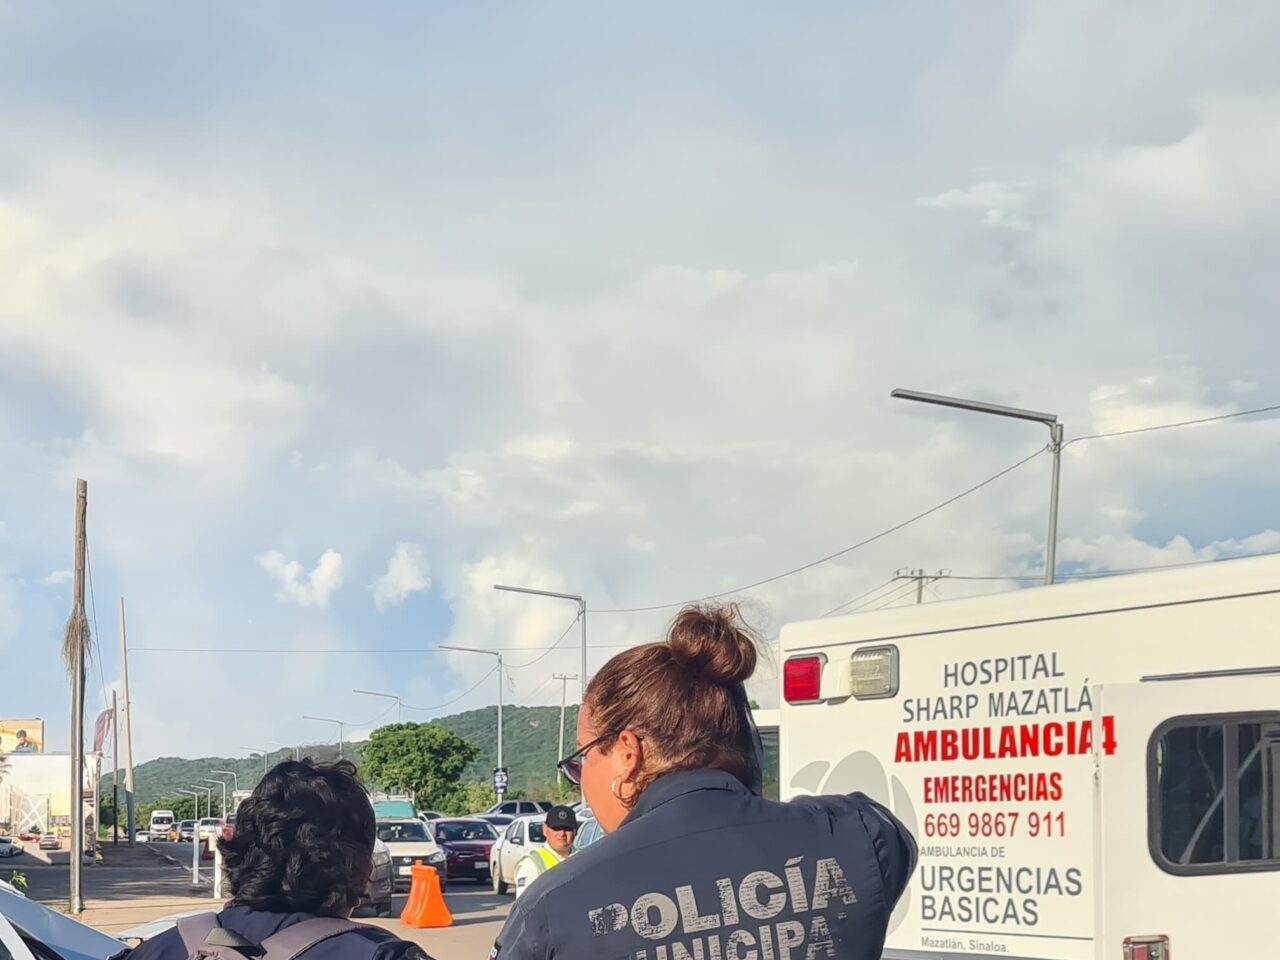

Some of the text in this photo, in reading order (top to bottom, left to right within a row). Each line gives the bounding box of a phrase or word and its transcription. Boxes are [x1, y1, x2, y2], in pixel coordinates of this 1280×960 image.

[943, 652, 1065, 688] HOSPITAL
[902, 678, 1093, 723] SHARP MAZATLÁ
[894, 720, 1094, 763] AMBULANCIA
[923, 772, 1063, 803] EMERGENCIAS
[924, 811, 1065, 837] 669 9867 911
[920, 846, 1006, 858] AMBULANCIA DE
[921, 866, 1082, 896] URGENCIAS
[588, 855, 857, 940] POLICÍA
[921, 895, 1039, 926] BASICAS
[921, 936, 1009, 953] Mazatlán, Sinaloa.
